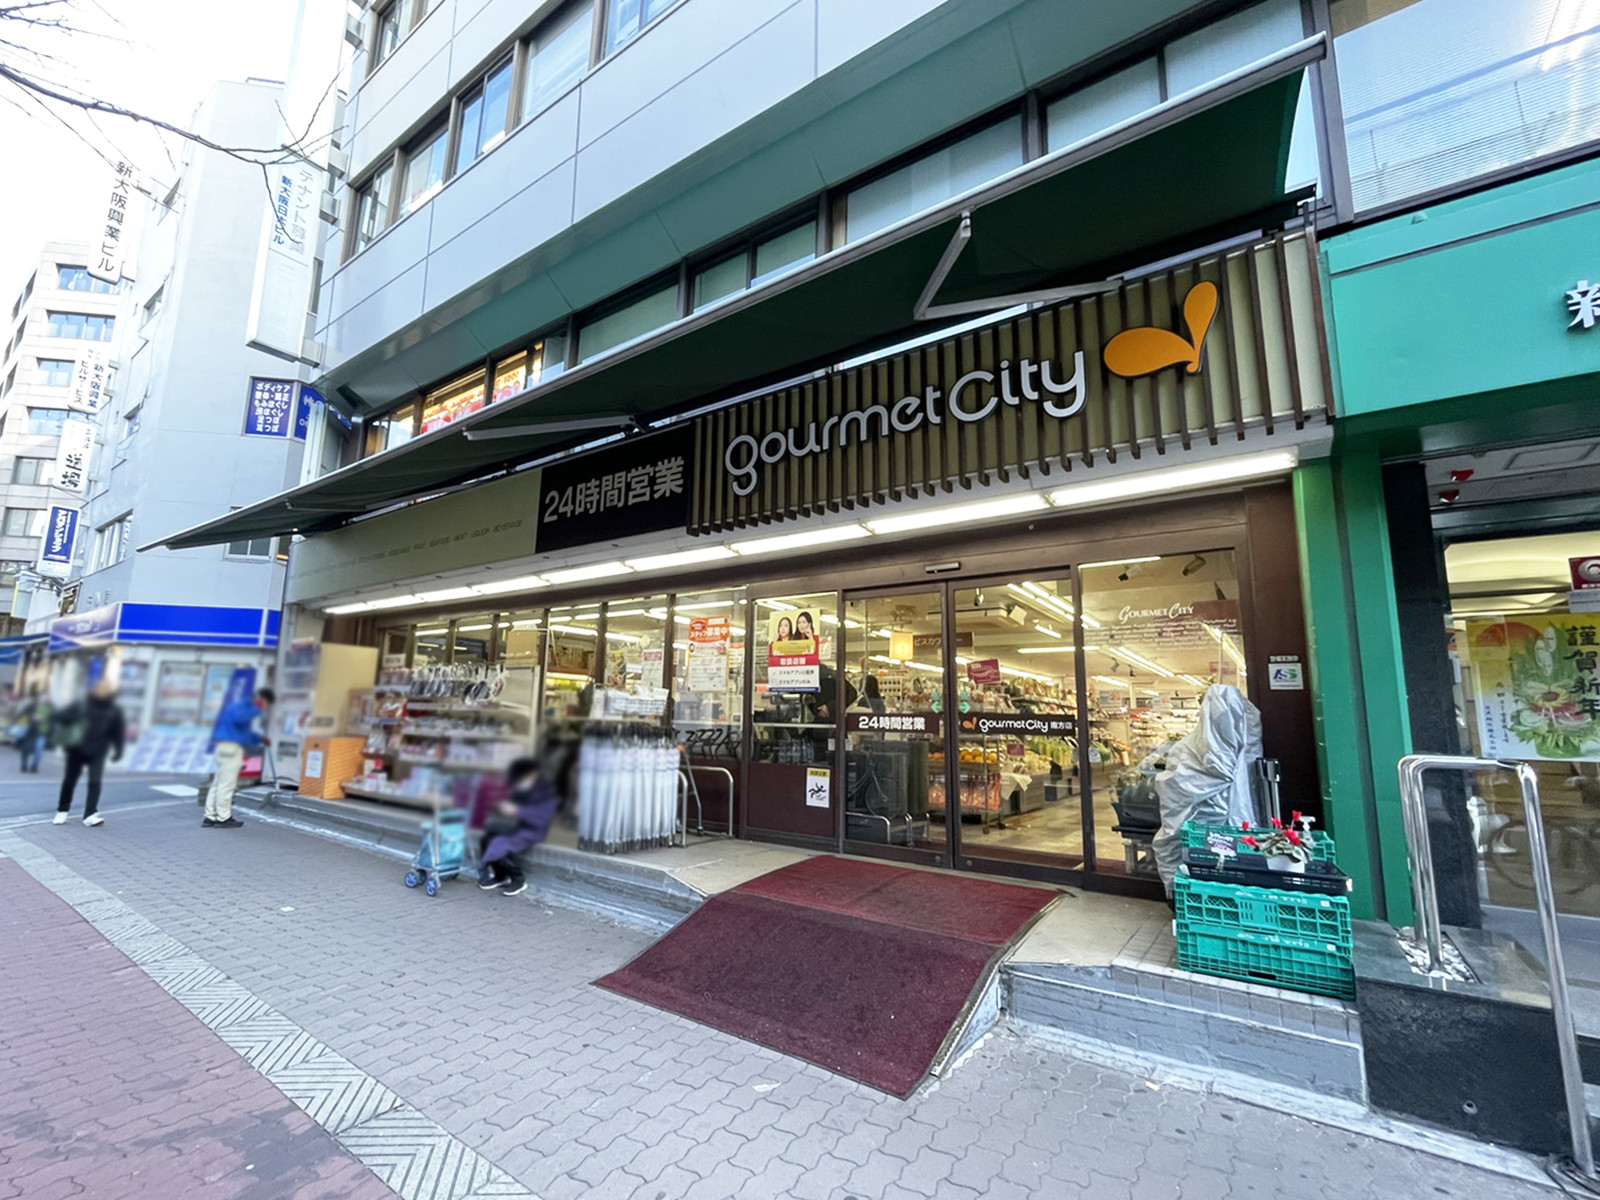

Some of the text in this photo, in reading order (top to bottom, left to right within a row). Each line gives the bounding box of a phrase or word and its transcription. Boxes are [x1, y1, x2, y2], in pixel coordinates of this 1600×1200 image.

[98, 161, 132, 272] 新大阪興業ビル
[254, 400, 288, 409] もみほぐし
[255, 382, 291, 392] ボディケア
[543, 456, 685, 523] 24時間営業
[1563, 625, 1600, 721] 謹賀新年
[858, 715, 926, 731] 24時間営業
